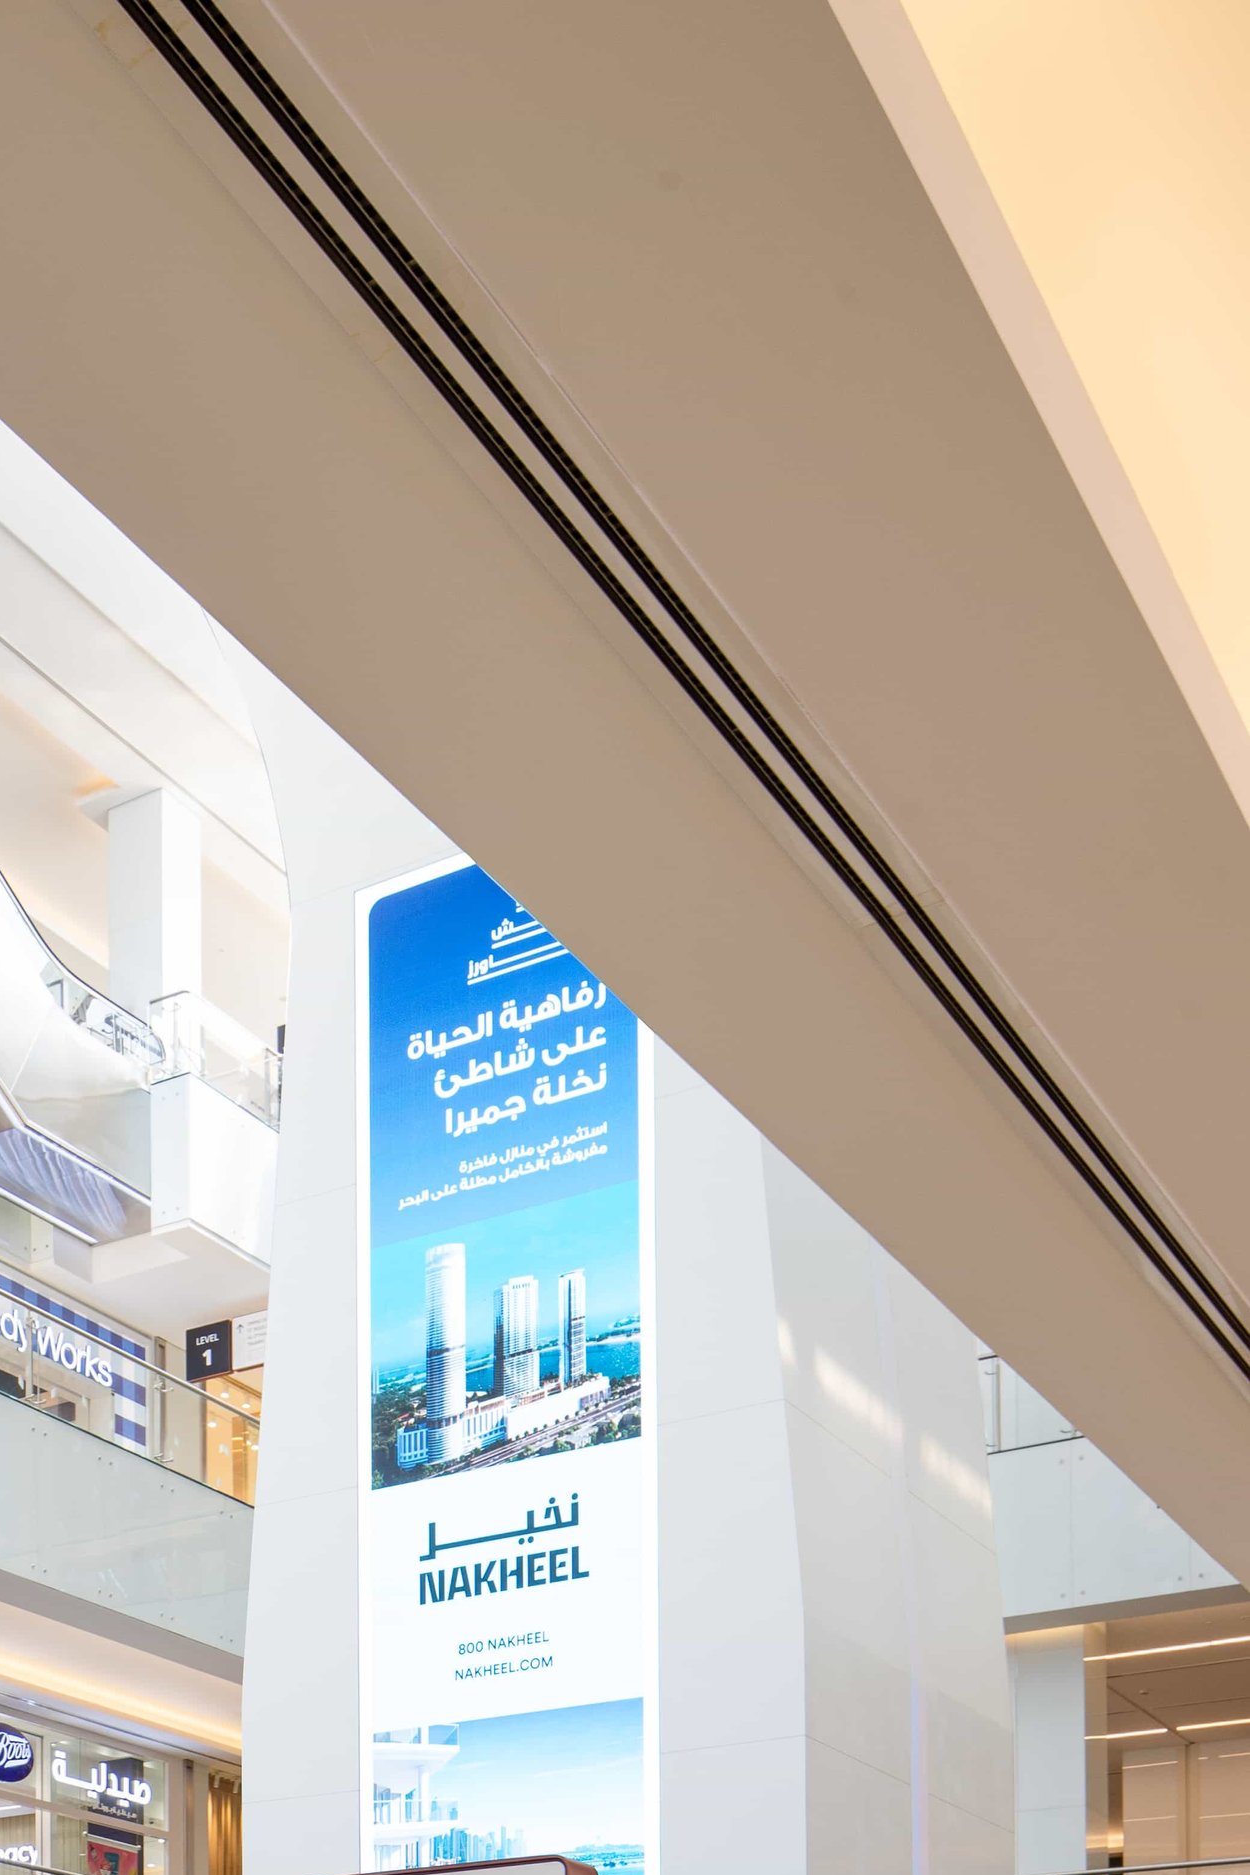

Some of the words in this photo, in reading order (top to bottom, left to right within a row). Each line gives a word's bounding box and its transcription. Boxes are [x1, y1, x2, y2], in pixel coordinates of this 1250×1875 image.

[499, 979, 608, 1033] رفاهية
[407, 1010, 493, 1060] الحياة
[541, 1025, 607, 1067] على
[434, 1037, 536, 1099] شاطئ
[532, 1062, 608, 1106] نخلة
[445, 1095, 527, 1137] جميرا
[536, 1135, 560, 1157] في
[562, 1121, 608, 1149] استثمر
[458, 1152, 498, 1174] فاخرة
[499, 1141, 534, 1167] منازل
[552, 1142, 608, 1167] مفروشة
[458, 1168, 497, 1191] مطلة
[499, 1157, 551, 1183] بالكامل
[397, 1186, 429, 1211] البحر
[431, 1180, 458, 1202] على
[195, 1333, 220, 1346] LEVEL
[37, 1328, 114, 1388] Works
[202, 1348, 212, 1367] 1
[419, 1492, 580, 1562] نخيل
[419, 1546, 590, 1605] NAKHEEL
[458, 1641, 484, 1656] 800
[487, 1631, 550, 1651] NAKHEEL
[454, 1655, 554, 1682] NAKHEEL.COM
[52, 1750, 152, 1807] صيدلية
